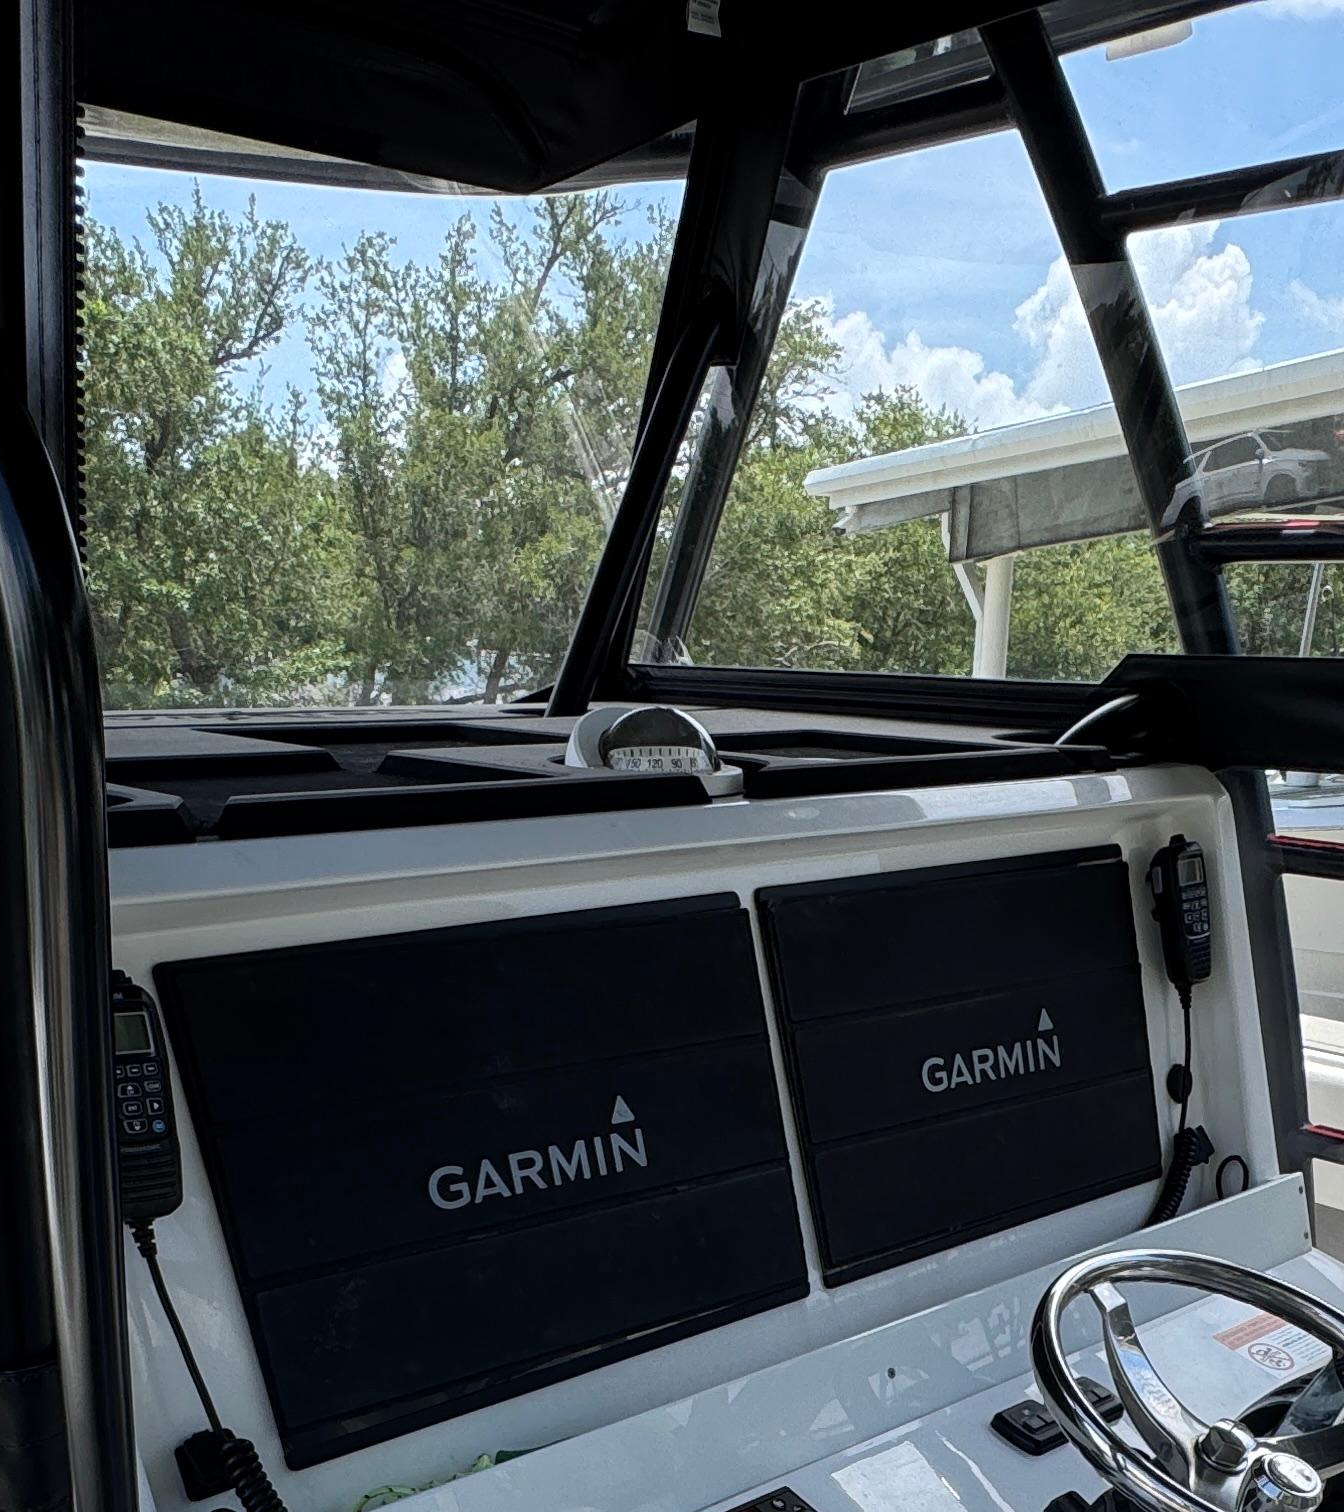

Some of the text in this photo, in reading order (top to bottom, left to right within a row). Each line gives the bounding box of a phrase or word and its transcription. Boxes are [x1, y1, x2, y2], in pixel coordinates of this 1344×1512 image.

[648, 758, 663, 769] 120
[671, 758, 683, 769] 90
[921, 1034, 1062, 1093] GARMIN
[428, 1128, 648, 1210] GARMIN
